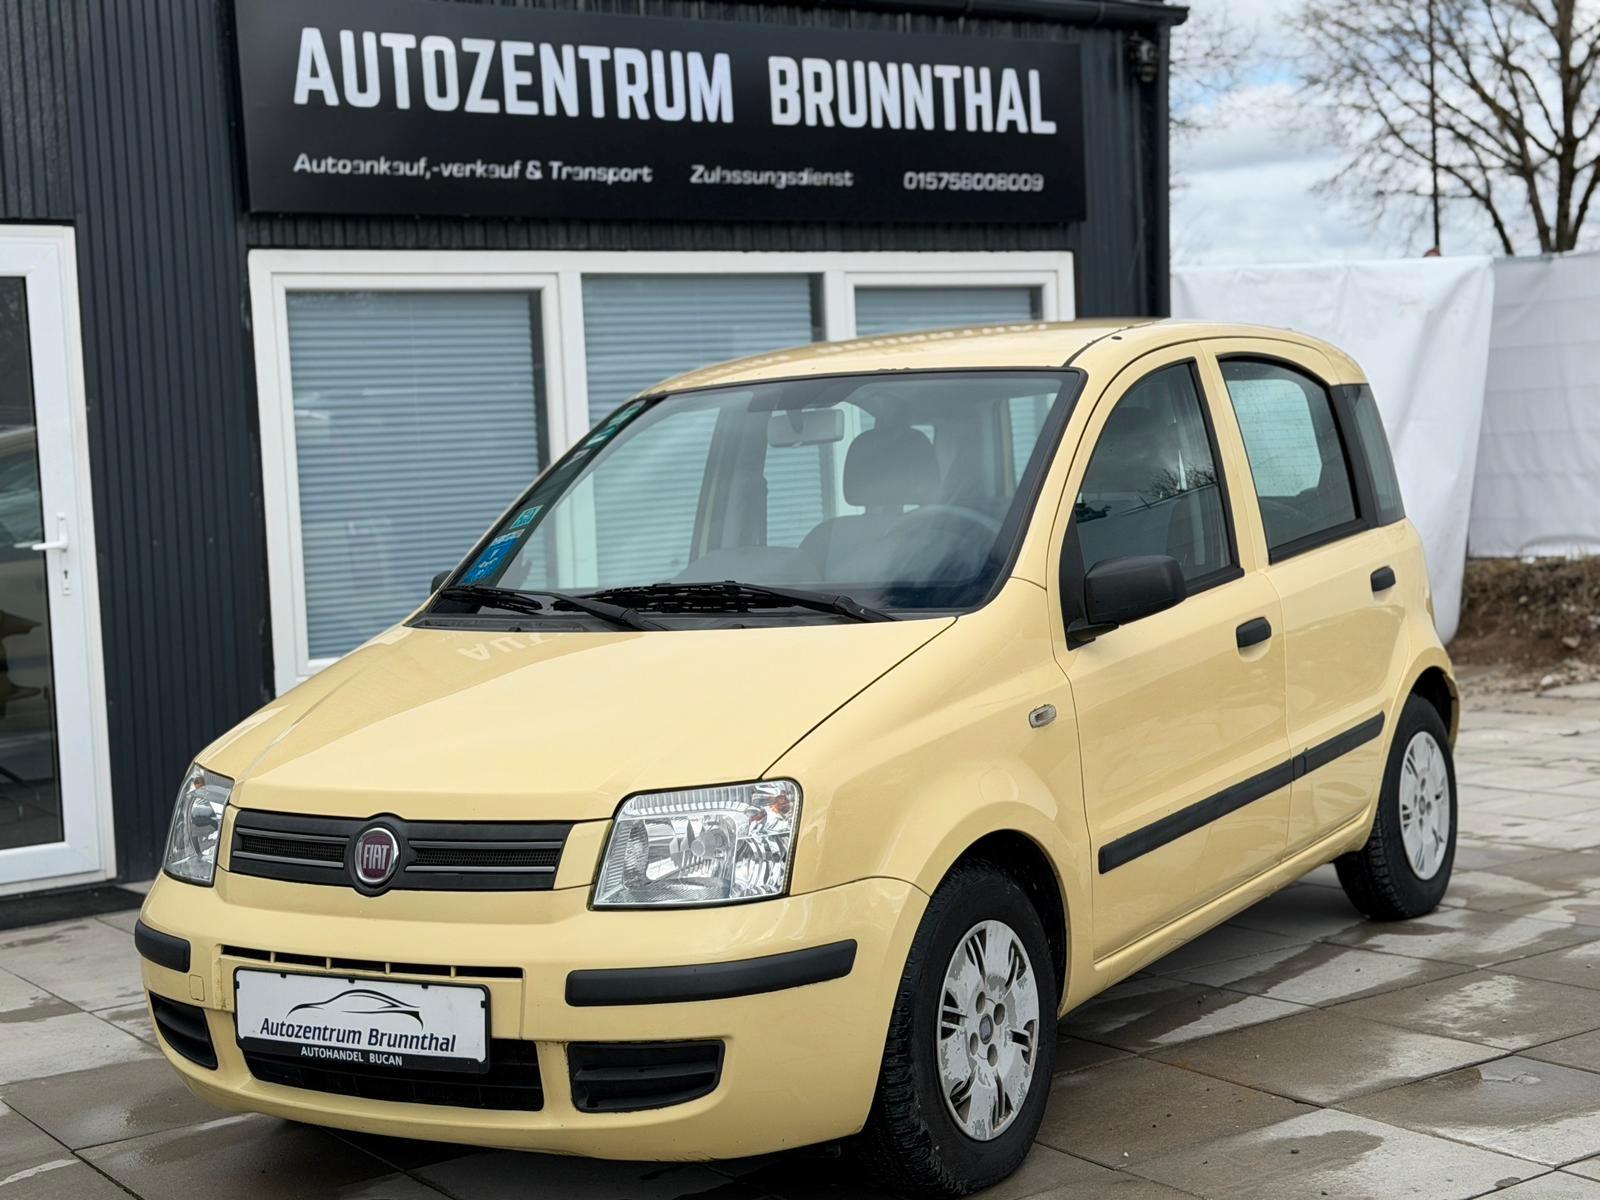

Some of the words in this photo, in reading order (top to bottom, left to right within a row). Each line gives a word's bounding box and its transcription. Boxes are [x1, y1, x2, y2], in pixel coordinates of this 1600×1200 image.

[294, 27, 733, 122] AUTOZENTRUM
[768, 55, 1057, 134] BRUNNTHAL
[525, 160, 543, 180] &
[548, 161, 653, 185] Transport
[689, 164, 853, 189] Zulassungsdienst
[362, 843, 390, 870] FIAT
[260, 1017, 362, 1045] Autozentrum
[367, 1027, 457, 1053] Brunnthal
[301, 1046, 364, 1063] AUTOHANDEL
[369, 1053, 403, 1067] BUCAN
